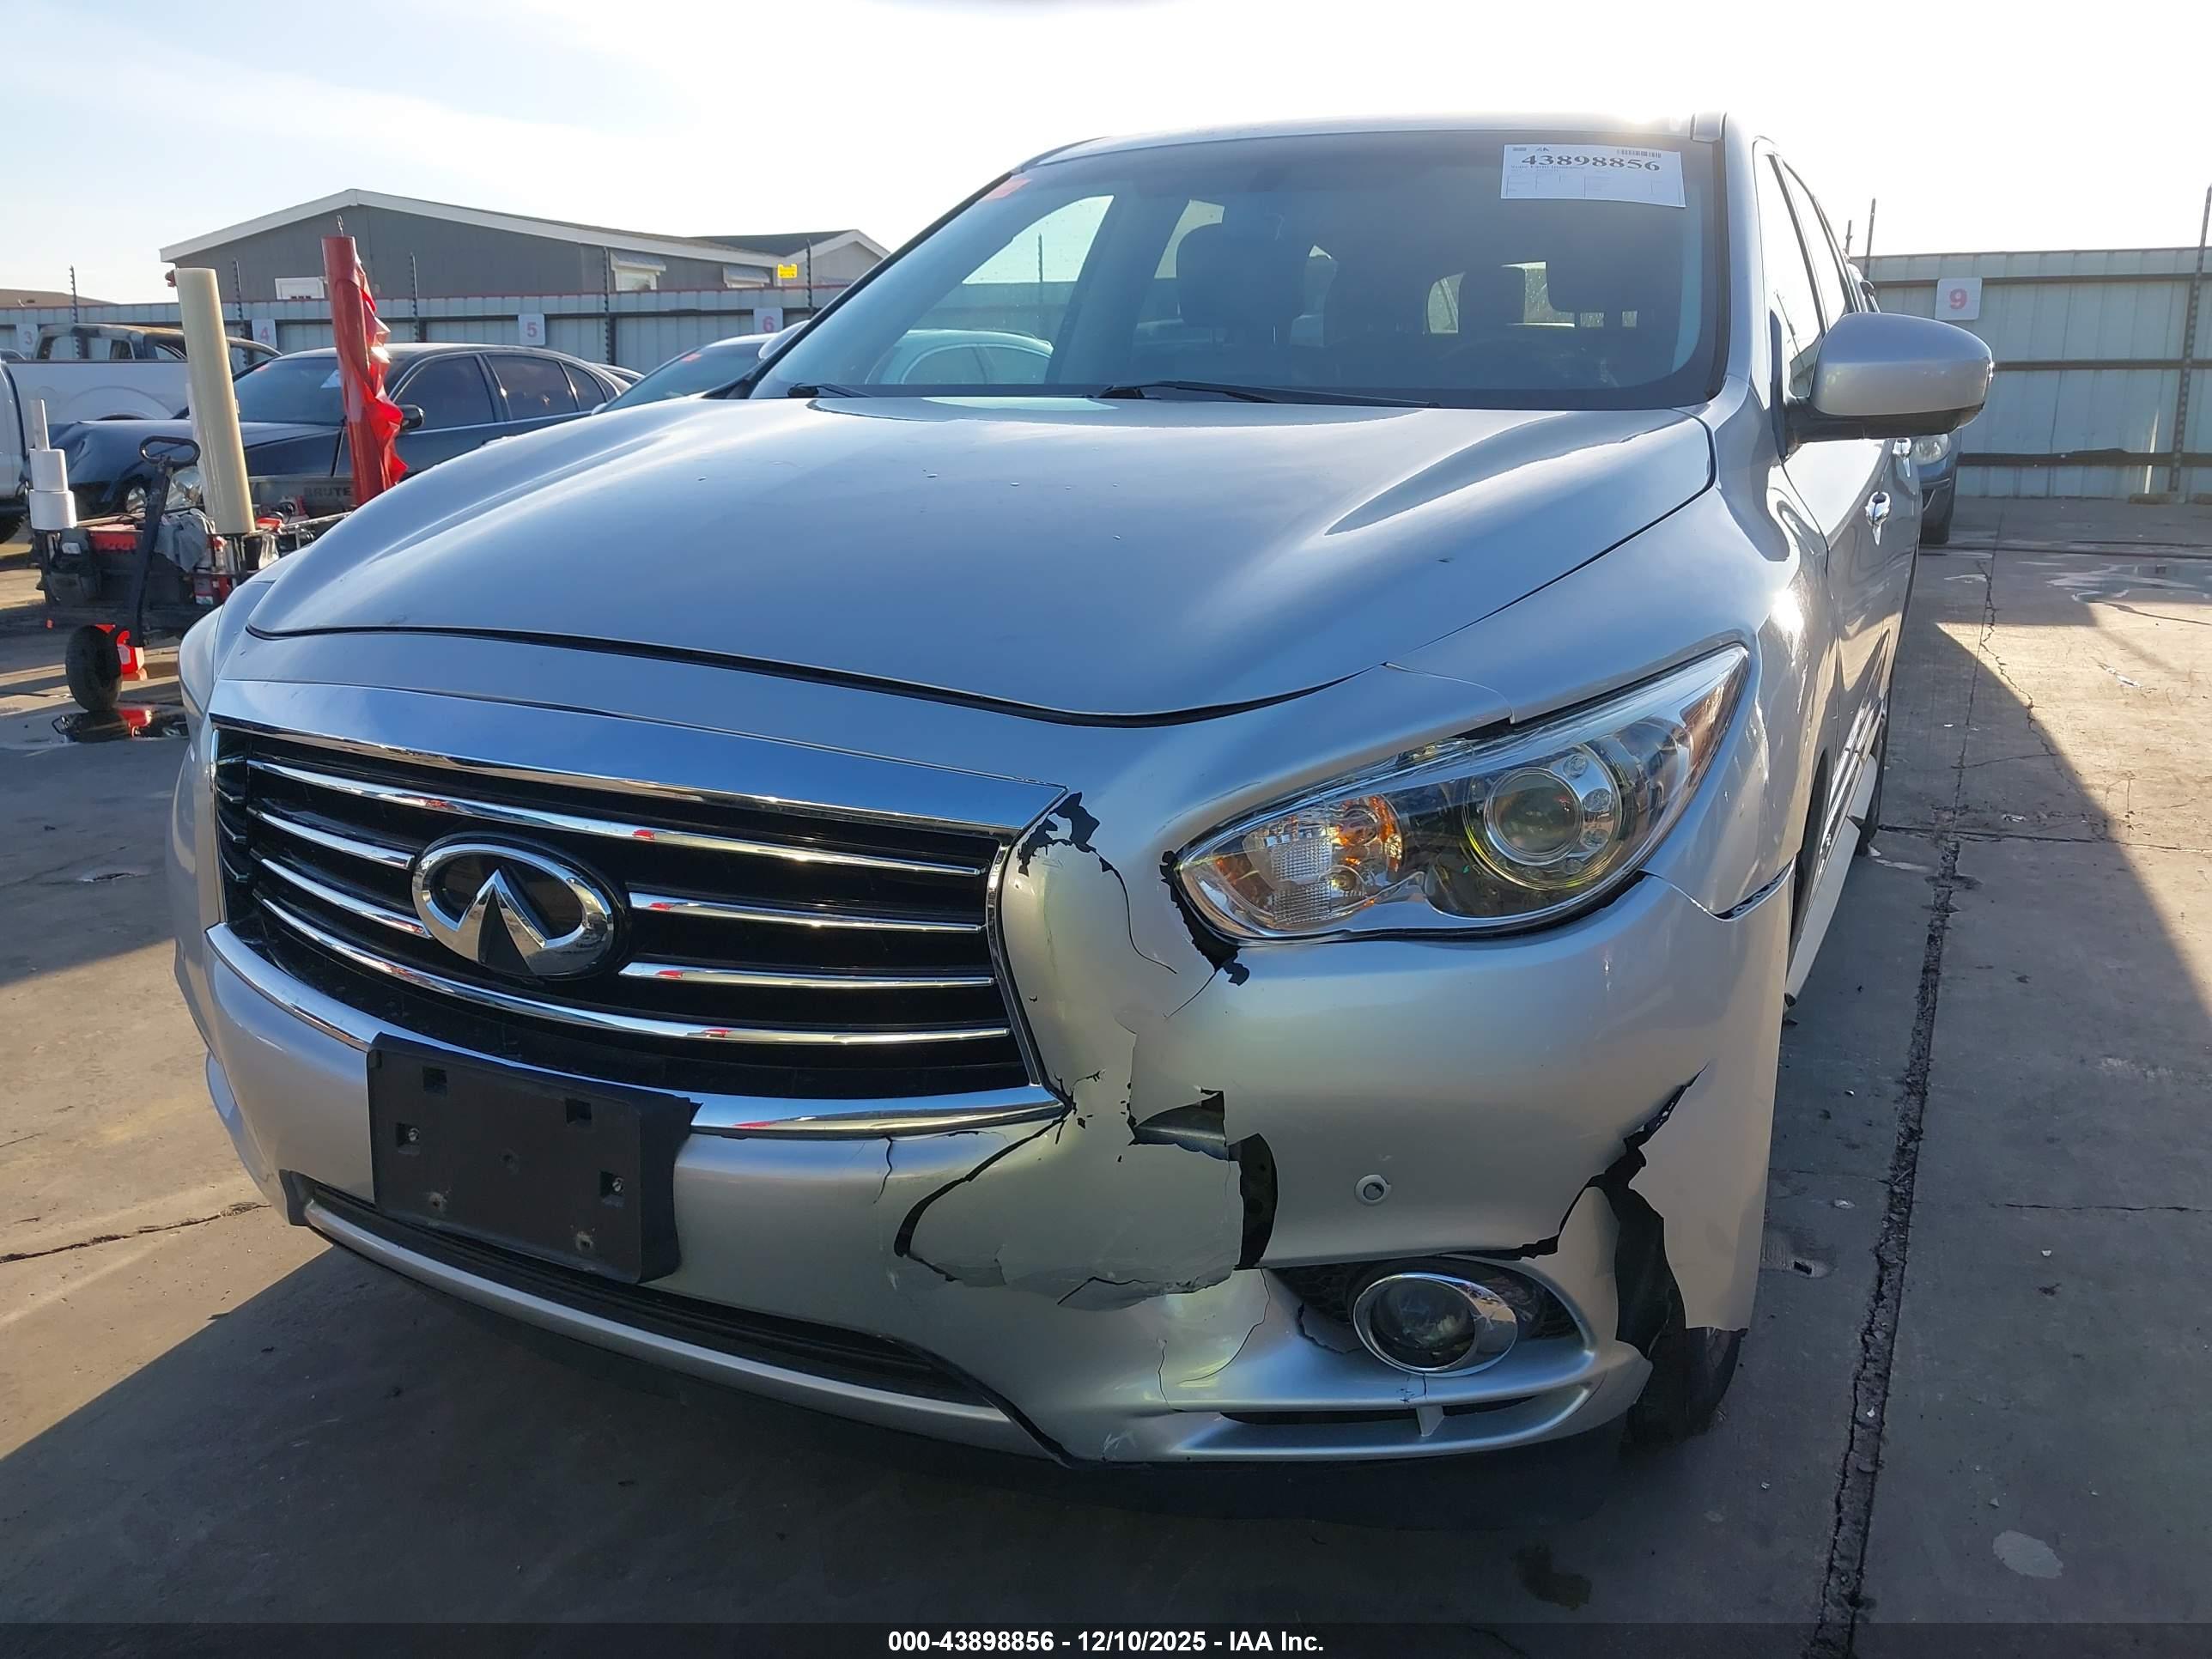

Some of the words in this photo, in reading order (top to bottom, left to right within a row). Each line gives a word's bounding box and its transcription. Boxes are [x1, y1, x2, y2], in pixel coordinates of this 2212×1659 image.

[1522, 155, 1660, 171] 43898856
[1950, 288, 1967, 310] 9
[526, 321, 538, 337] 5
[763, 315, 775, 333] 6
[23, 330, 33, 345] 3
[260, 326, 270, 342] 4
[303, 487, 351, 496] BRUTE
